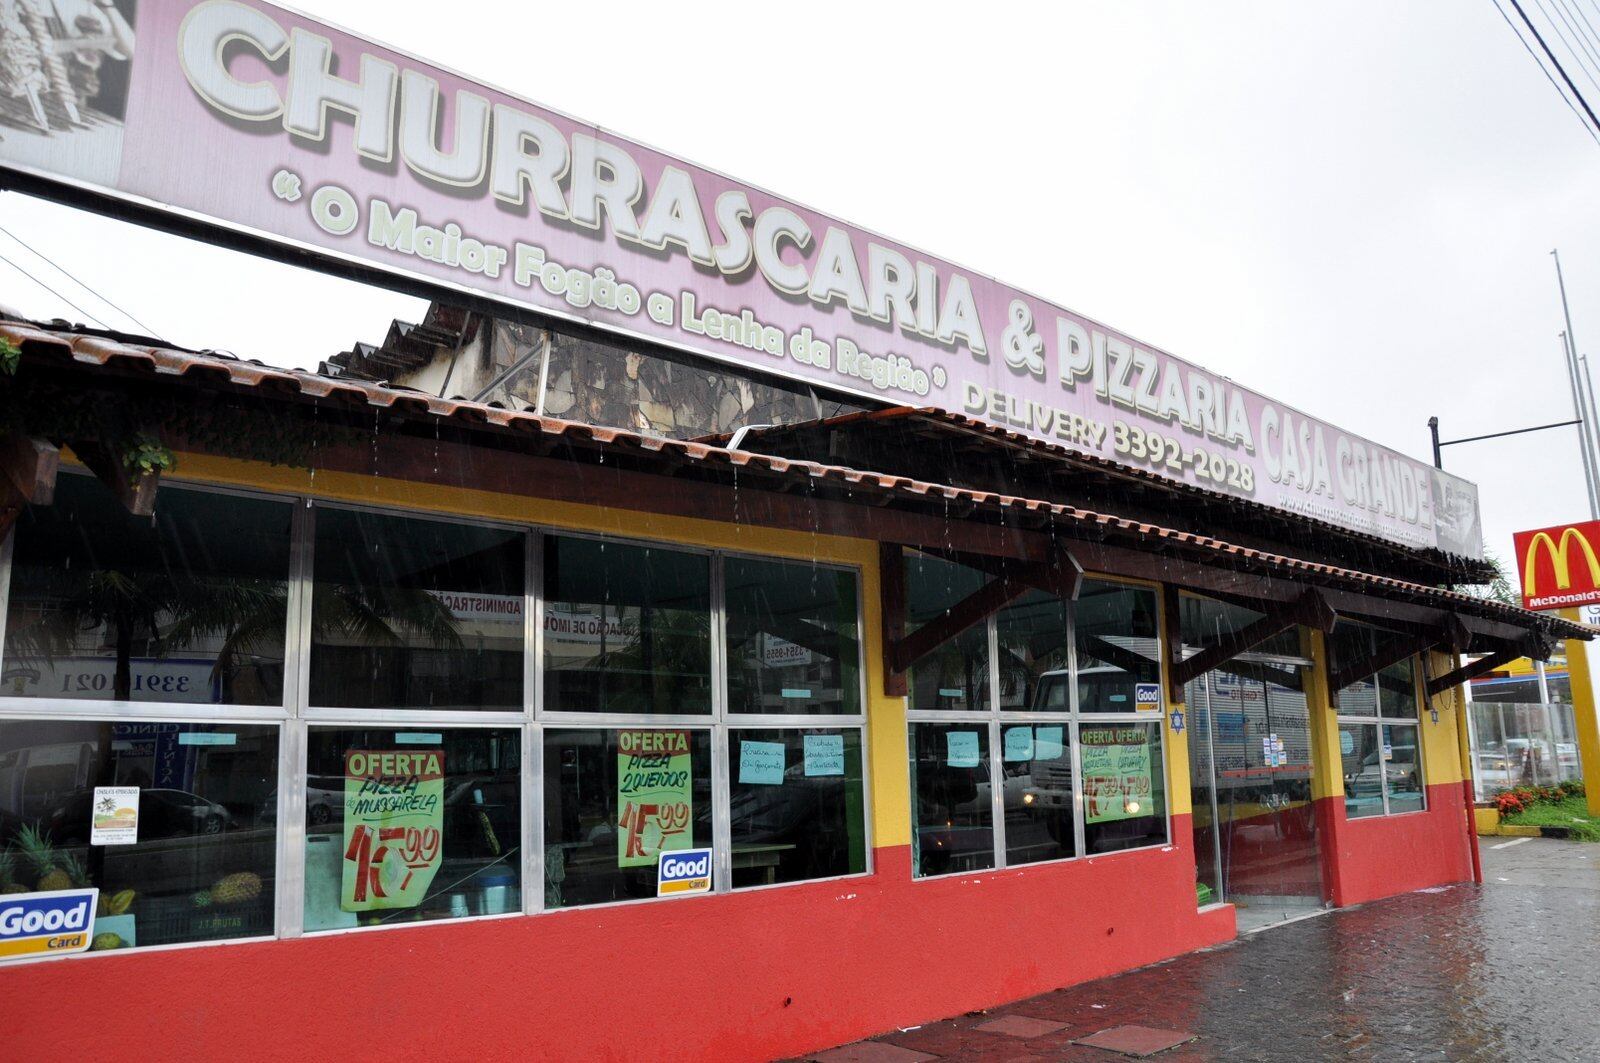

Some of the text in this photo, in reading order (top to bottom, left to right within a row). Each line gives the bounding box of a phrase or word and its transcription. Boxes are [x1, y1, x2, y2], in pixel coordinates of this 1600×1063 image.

[177, 0, 1432, 530] CHURRASCARIA & PIZZARIA CASA GRANDE
[367, 200, 506, 278] Maior
[515, 241, 640, 316] Fogão
[648, 293, 673, 325] a
[682, 292, 784, 358] Lenha
[790, 327, 831, 368] da
[837, 345, 929, 395] Região
[963, 381, 1255, 493] DELIVERY 3392-2028
[1530, 590, 1600, 607] McDonald's
[1137, 689, 1158, 701] Good
[619, 732, 689, 751] OFERTA
[1081, 729, 1146, 744] OFERTA OFERTA
[348, 753, 441, 776] OFERTA
[628, 753, 671, 770] PIZZA
[358, 774, 420, 796] PIZZA
[353, 793, 438, 816] MUSSARELA
[662, 857, 707, 878] Good
[689, 879, 706, 889] Card
[0, 902, 87, 935] Good
[47, 936, 81, 948] Card
